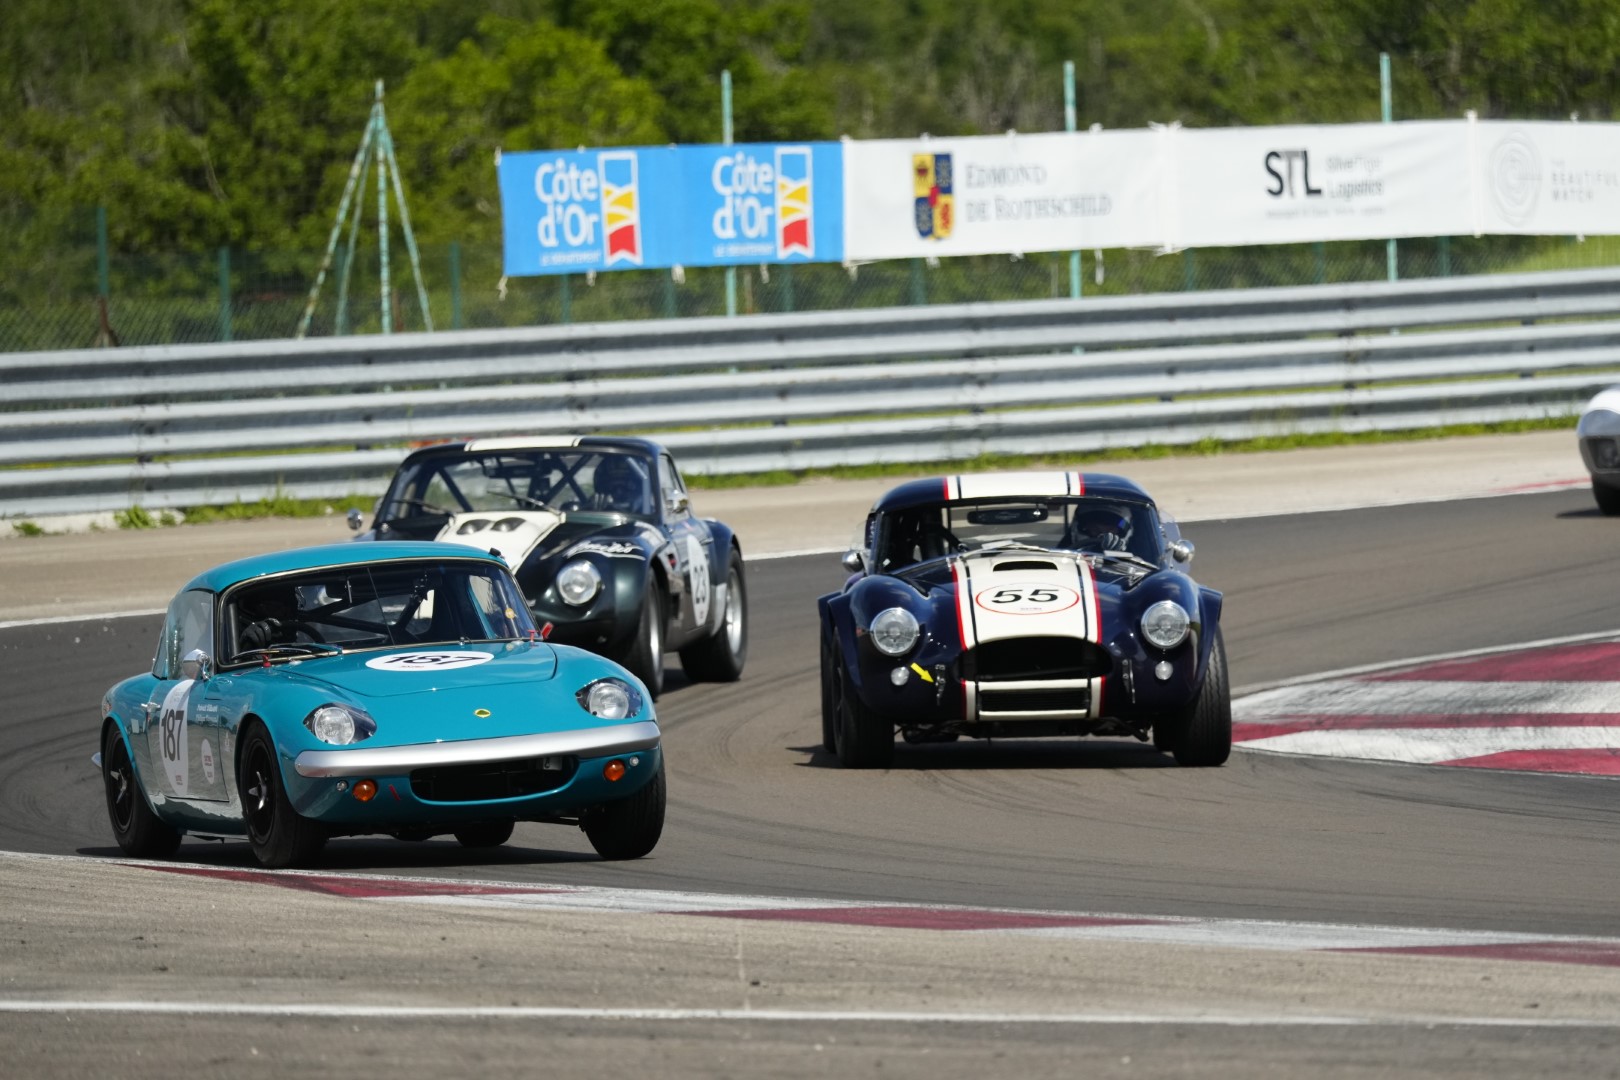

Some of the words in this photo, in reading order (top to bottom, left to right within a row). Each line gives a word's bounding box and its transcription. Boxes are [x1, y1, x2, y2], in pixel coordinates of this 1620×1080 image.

[534, 158, 599, 204] Côte
[712, 151, 774, 197] Côte
[965, 162, 1047, 188] EDMOND
[1265, 148, 1322, 197] STL
[537, 201, 599, 247] d'Or
[712, 195, 774, 239] d'Or
[994, 192, 1113, 221] ROTHSCHILD
[694, 566, 706, 604] 23
[991, 589, 1059, 604] 55
[385, 655, 486, 665] 187
[161, 709, 185, 762] 187
